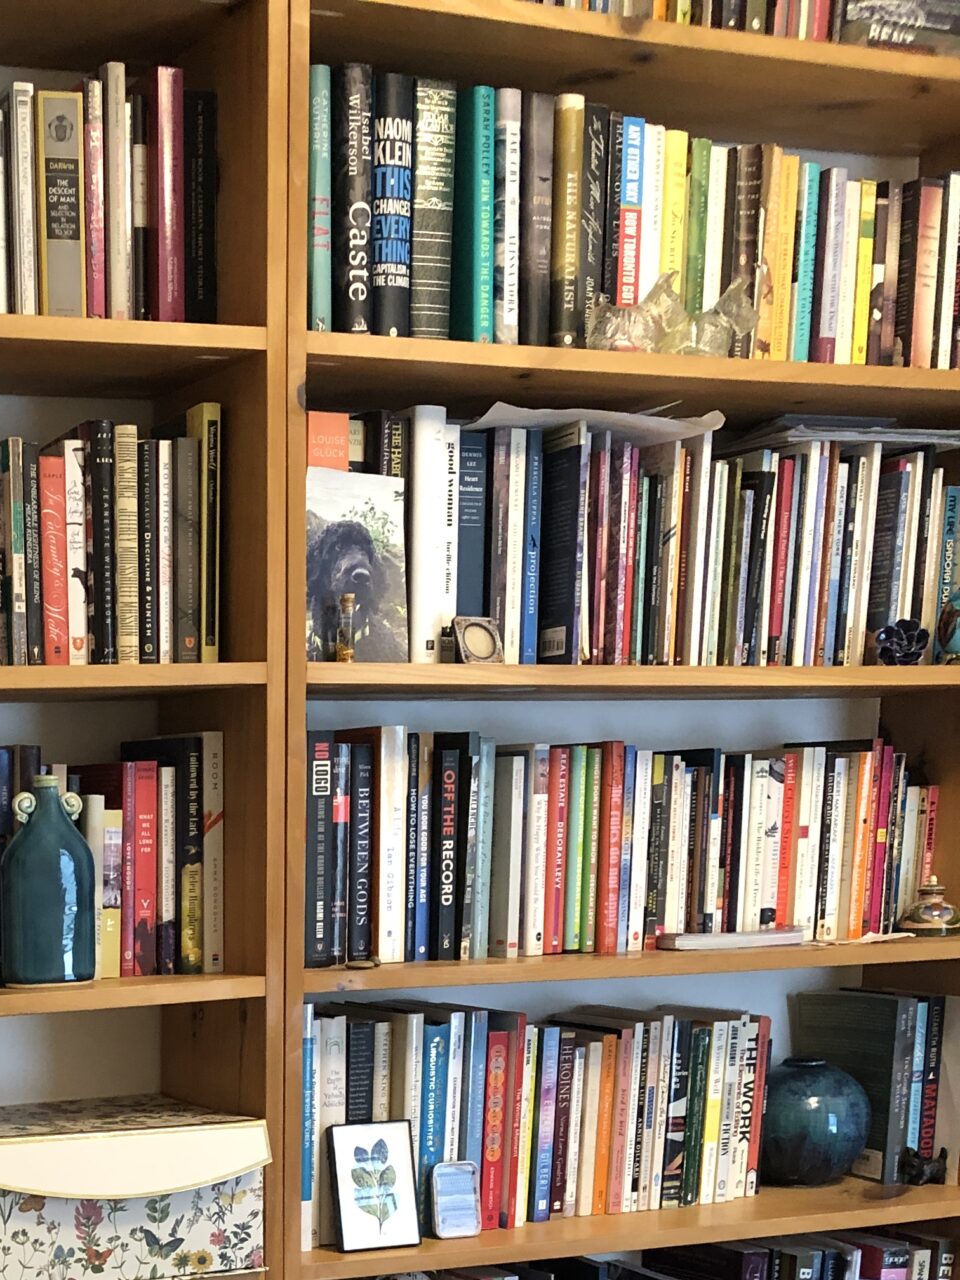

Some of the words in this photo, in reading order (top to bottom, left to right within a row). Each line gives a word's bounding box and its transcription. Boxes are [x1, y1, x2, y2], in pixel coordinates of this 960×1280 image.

[482, 94, 490, 132] SARAH
[348, 94, 360, 177] Wilkerson
[362, 111, 371, 161] Isabel
[482, 135, 490, 176] POLLEY
[627, 124, 639, 146] ANY
[374, 169, 411, 199] THIS
[626, 148, 638, 181] OTHER
[481, 179, 490, 202] RUN
[566, 172, 577, 206] THE
[625, 182, 638, 205] WAY
[312, 195, 330, 252] FLAT
[373, 217, 410, 240] EVERY
[480, 206, 490, 259] TOWARDS
[624, 212, 638, 236] HOW
[348, 201, 371, 302] Caste
[480, 262, 490, 282] THE
[564, 211, 576, 312] NATURALIST
[622, 238, 636, 282] TORONTO
[480, 285, 490, 328] DANGER
[621, 284, 634, 305] GOT
[446, 442, 456, 475] good
[102, 488, 110, 548] JEANETTE
[446, 479, 455, 528] woman
[527, 551, 538, 615] projection
[315, 742, 329, 760] NO
[315, 764, 329, 794] LOGO
[409, 788, 417, 811] HOW
[443, 770, 455, 802] OFF
[357, 788, 369, 875] BETWEEN
[408, 827, 416, 850] LOSE
[409, 812, 416, 826] TO
[443, 806, 455, 836] THE
[555, 822, 563, 865] DEBORAH
[407, 852, 416, 909] EVERYTHING
[441, 840, 454, 906] RECORD
[355, 878, 369, 926] GODS
[427, 1042, 437, 1091] LINGUISTIC
[558, 1045, 572, 1109] HEROINES
[426, 1093, 435, 1148] CURIOSITIES
